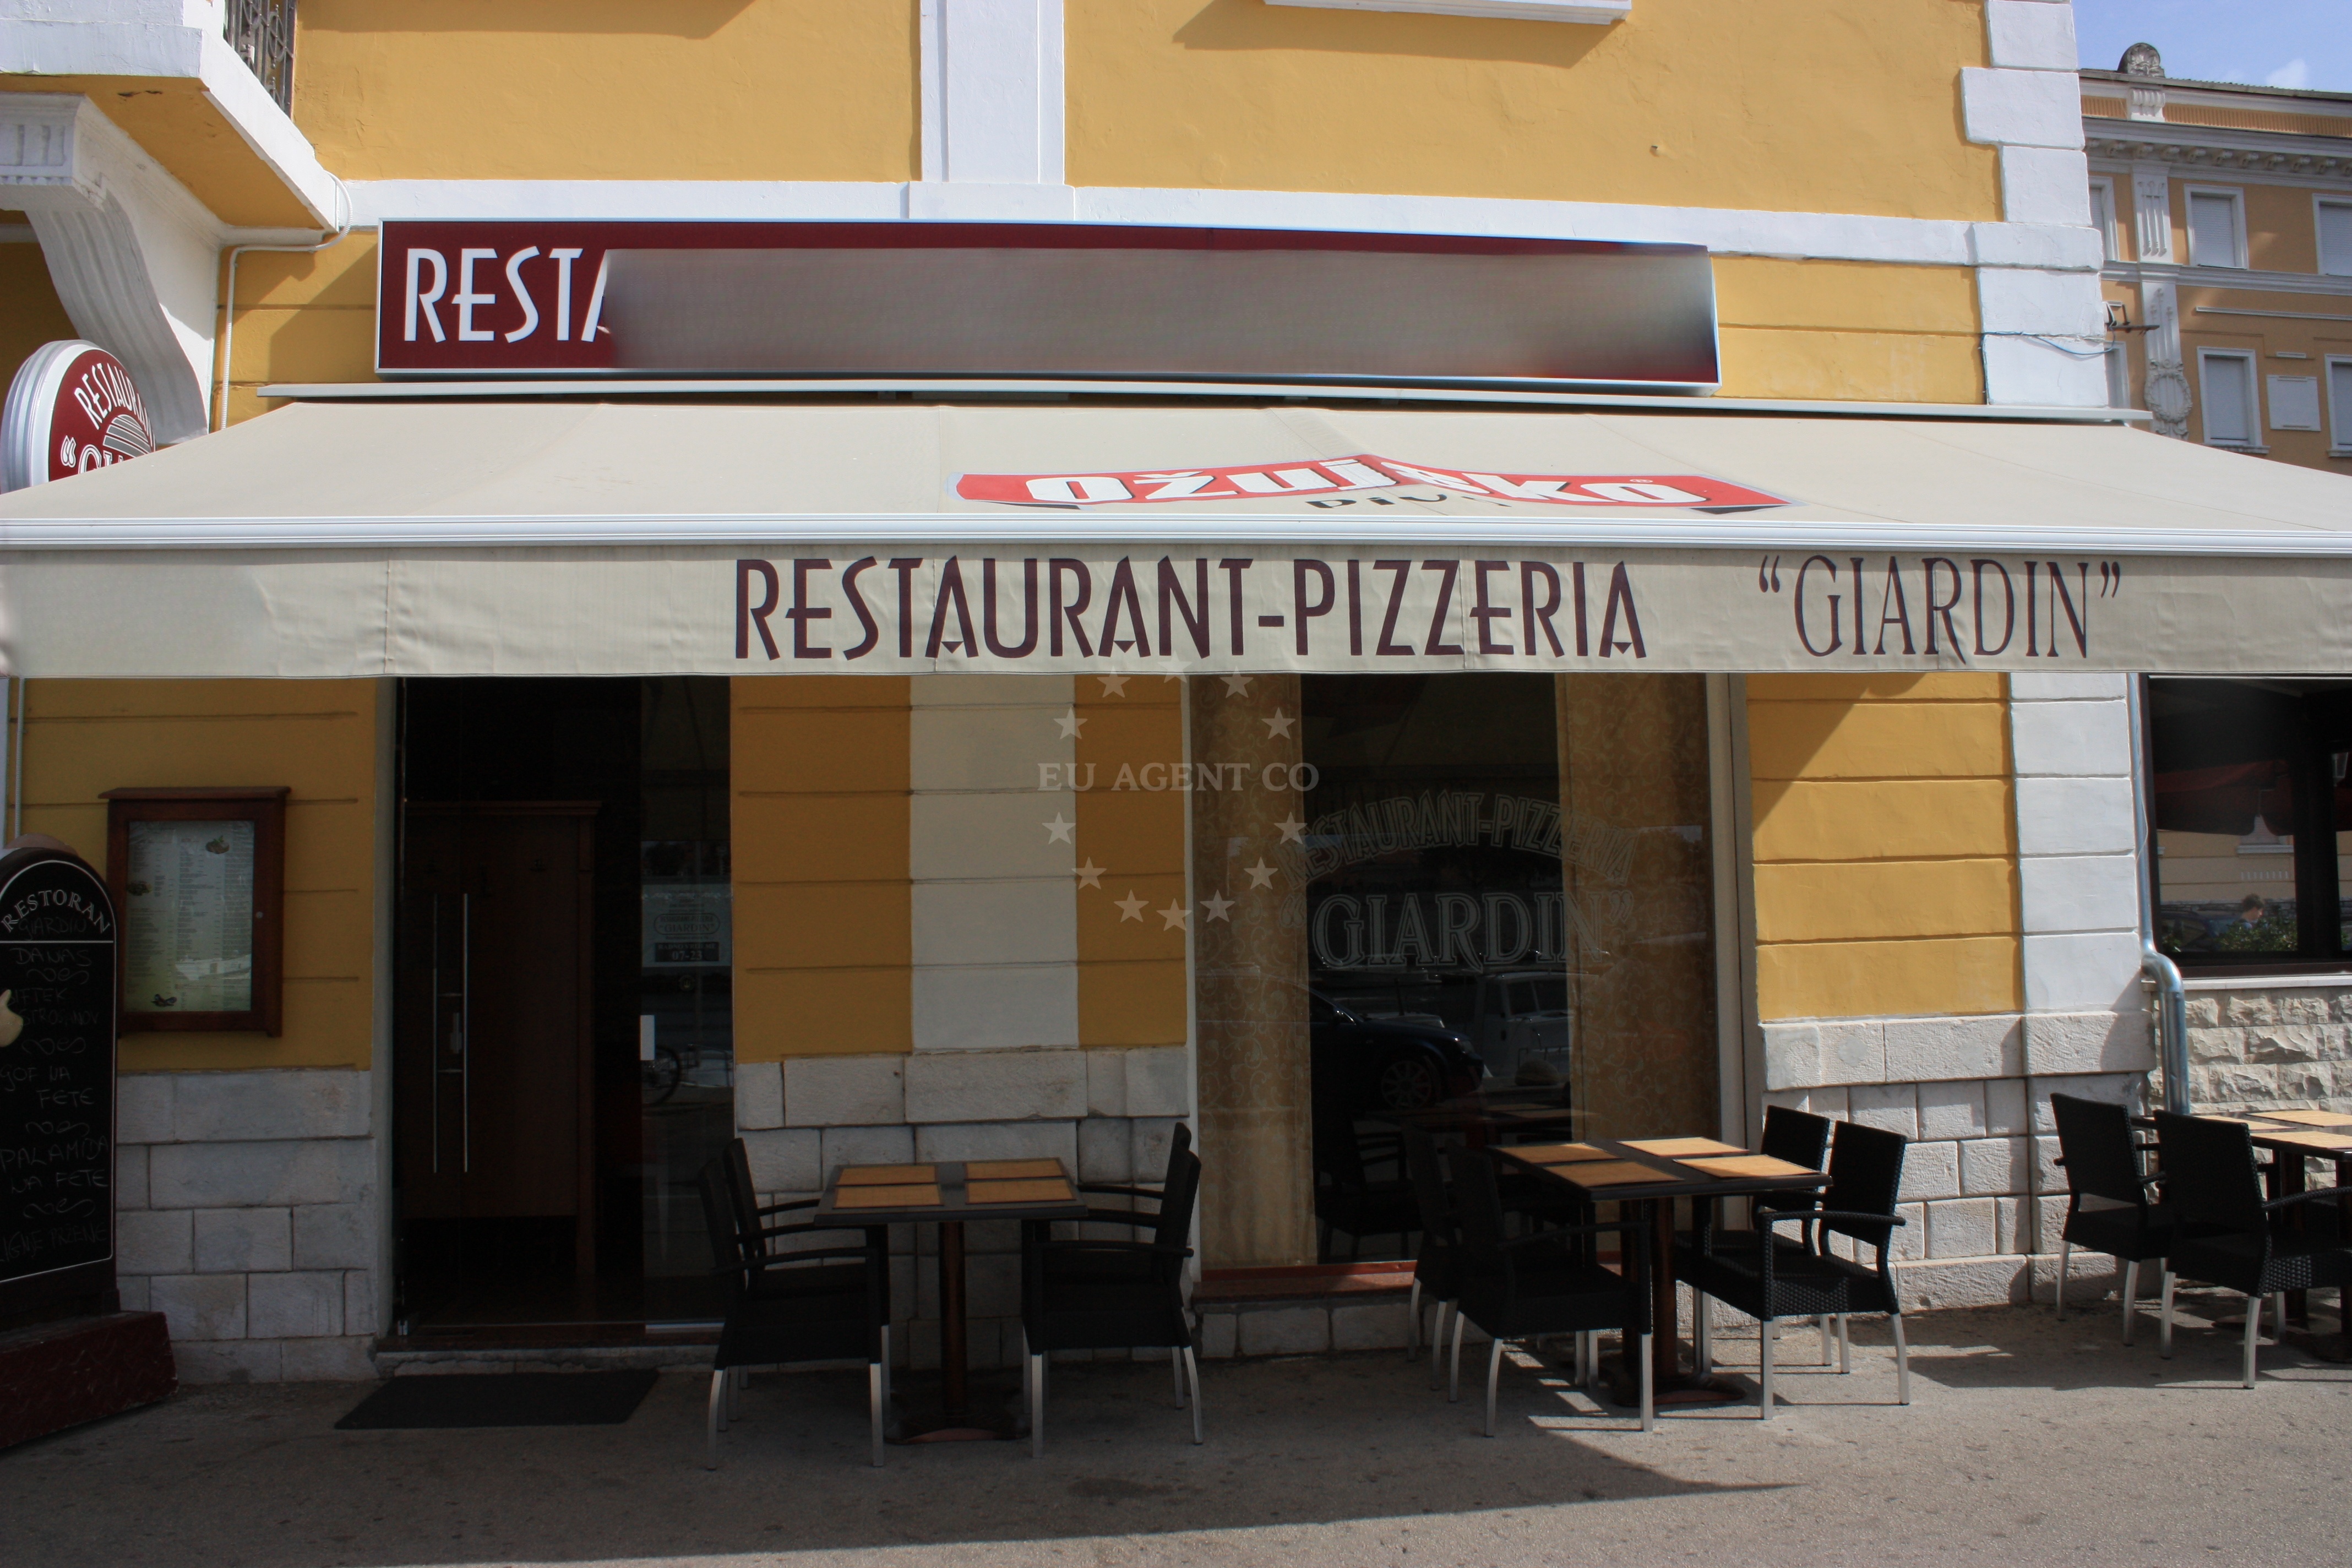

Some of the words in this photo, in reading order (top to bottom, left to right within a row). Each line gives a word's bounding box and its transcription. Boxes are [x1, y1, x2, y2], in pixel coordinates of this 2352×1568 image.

[735, 554, 1646, 661] RESTAURANT-PIZZERIA
[1758, 554, 2120, 665] “GIARDIN”
[1271, 788, 1641, 890] RESTAURANT-PIZZERIA
[1, 889, 111, 934] RESTORAN
[672, 950, 703, 960] 07-23
[36, 1088, 95, 1109] FETE
[0, 1135, 110, 1173] PALAMIDA
[56, 1169, 109, 1188] FETE
